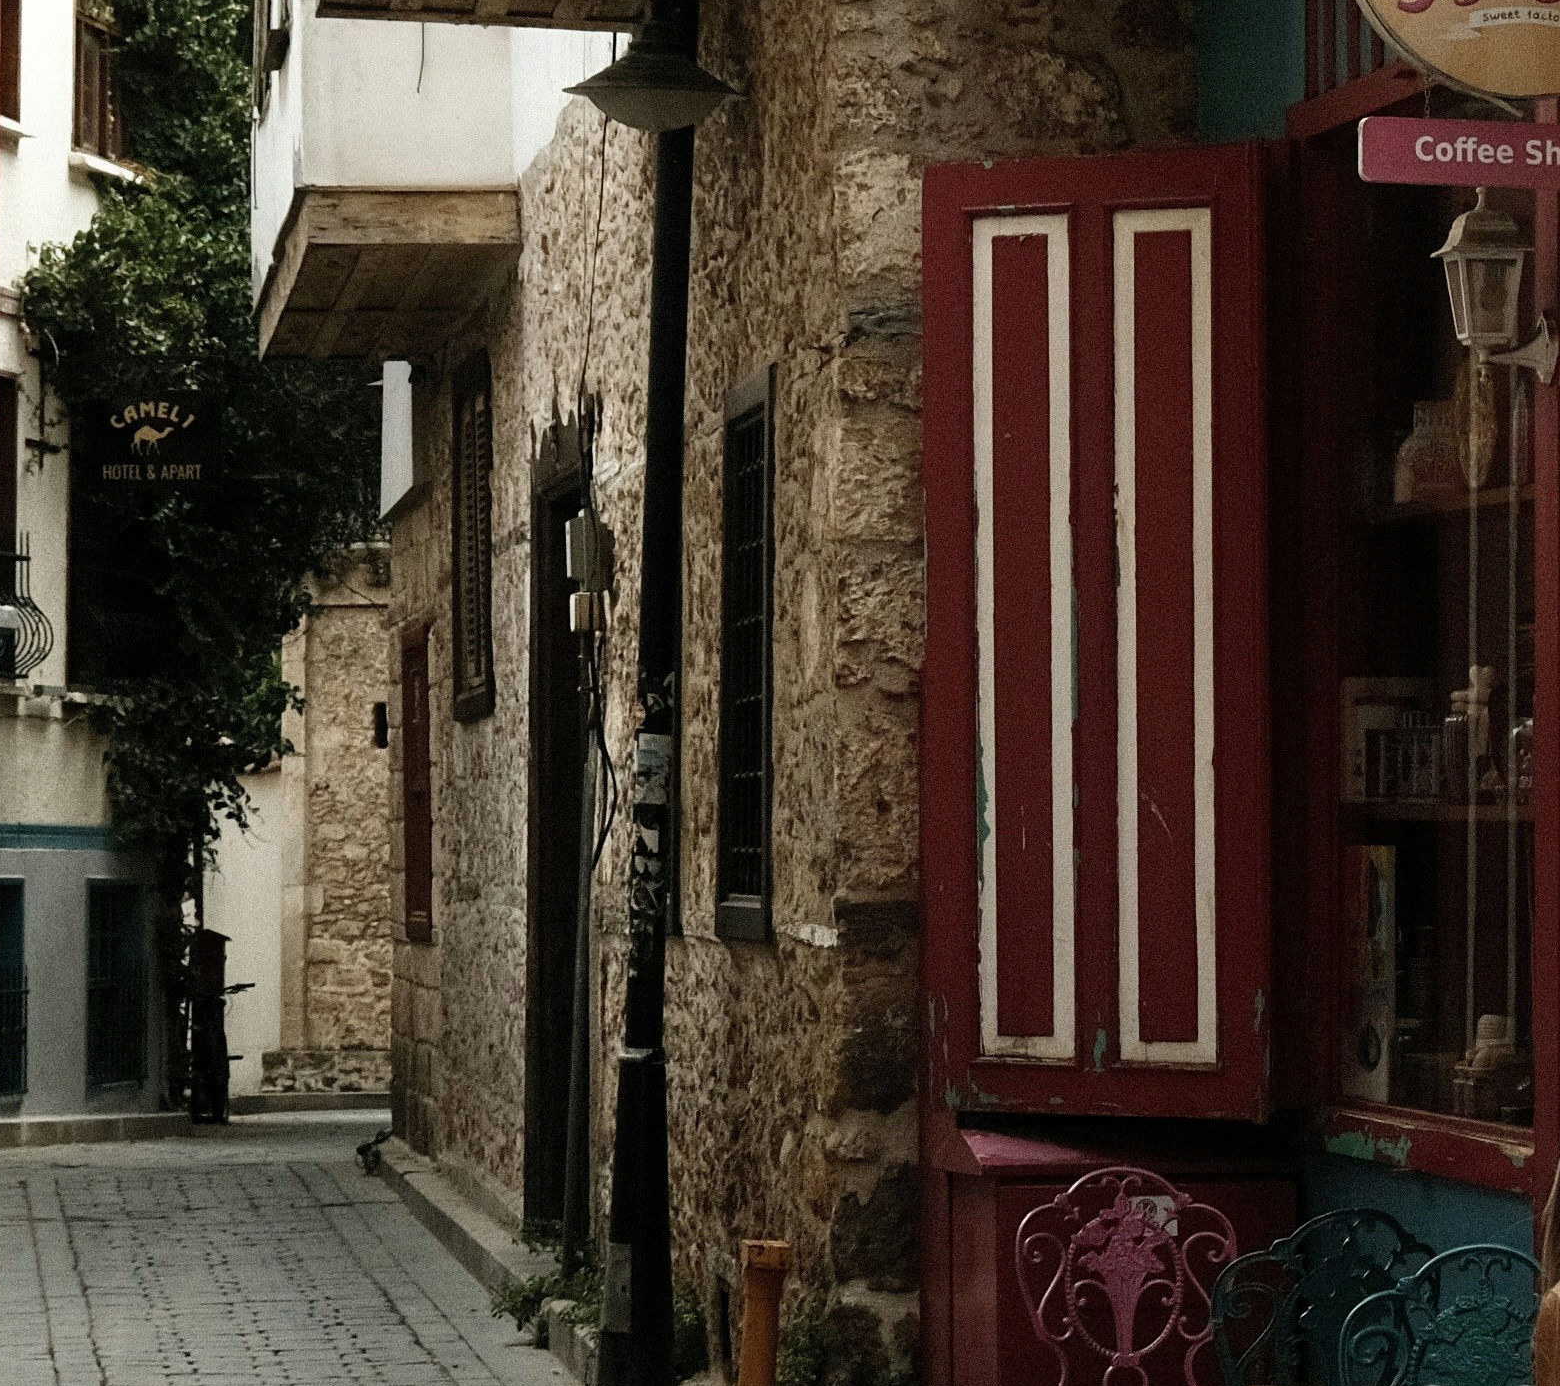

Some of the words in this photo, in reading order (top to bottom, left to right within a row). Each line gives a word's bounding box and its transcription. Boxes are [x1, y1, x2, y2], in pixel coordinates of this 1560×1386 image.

[1482, 9, 1522, 24] sweet
[1414, 135, 1515, 164] Coffee
[109, 401, 180, 430] CAMEL
[102, 464, 142, 480] HOTEL
[146, 464, 156, 480] &
[160, 464, 202, 480] APART
